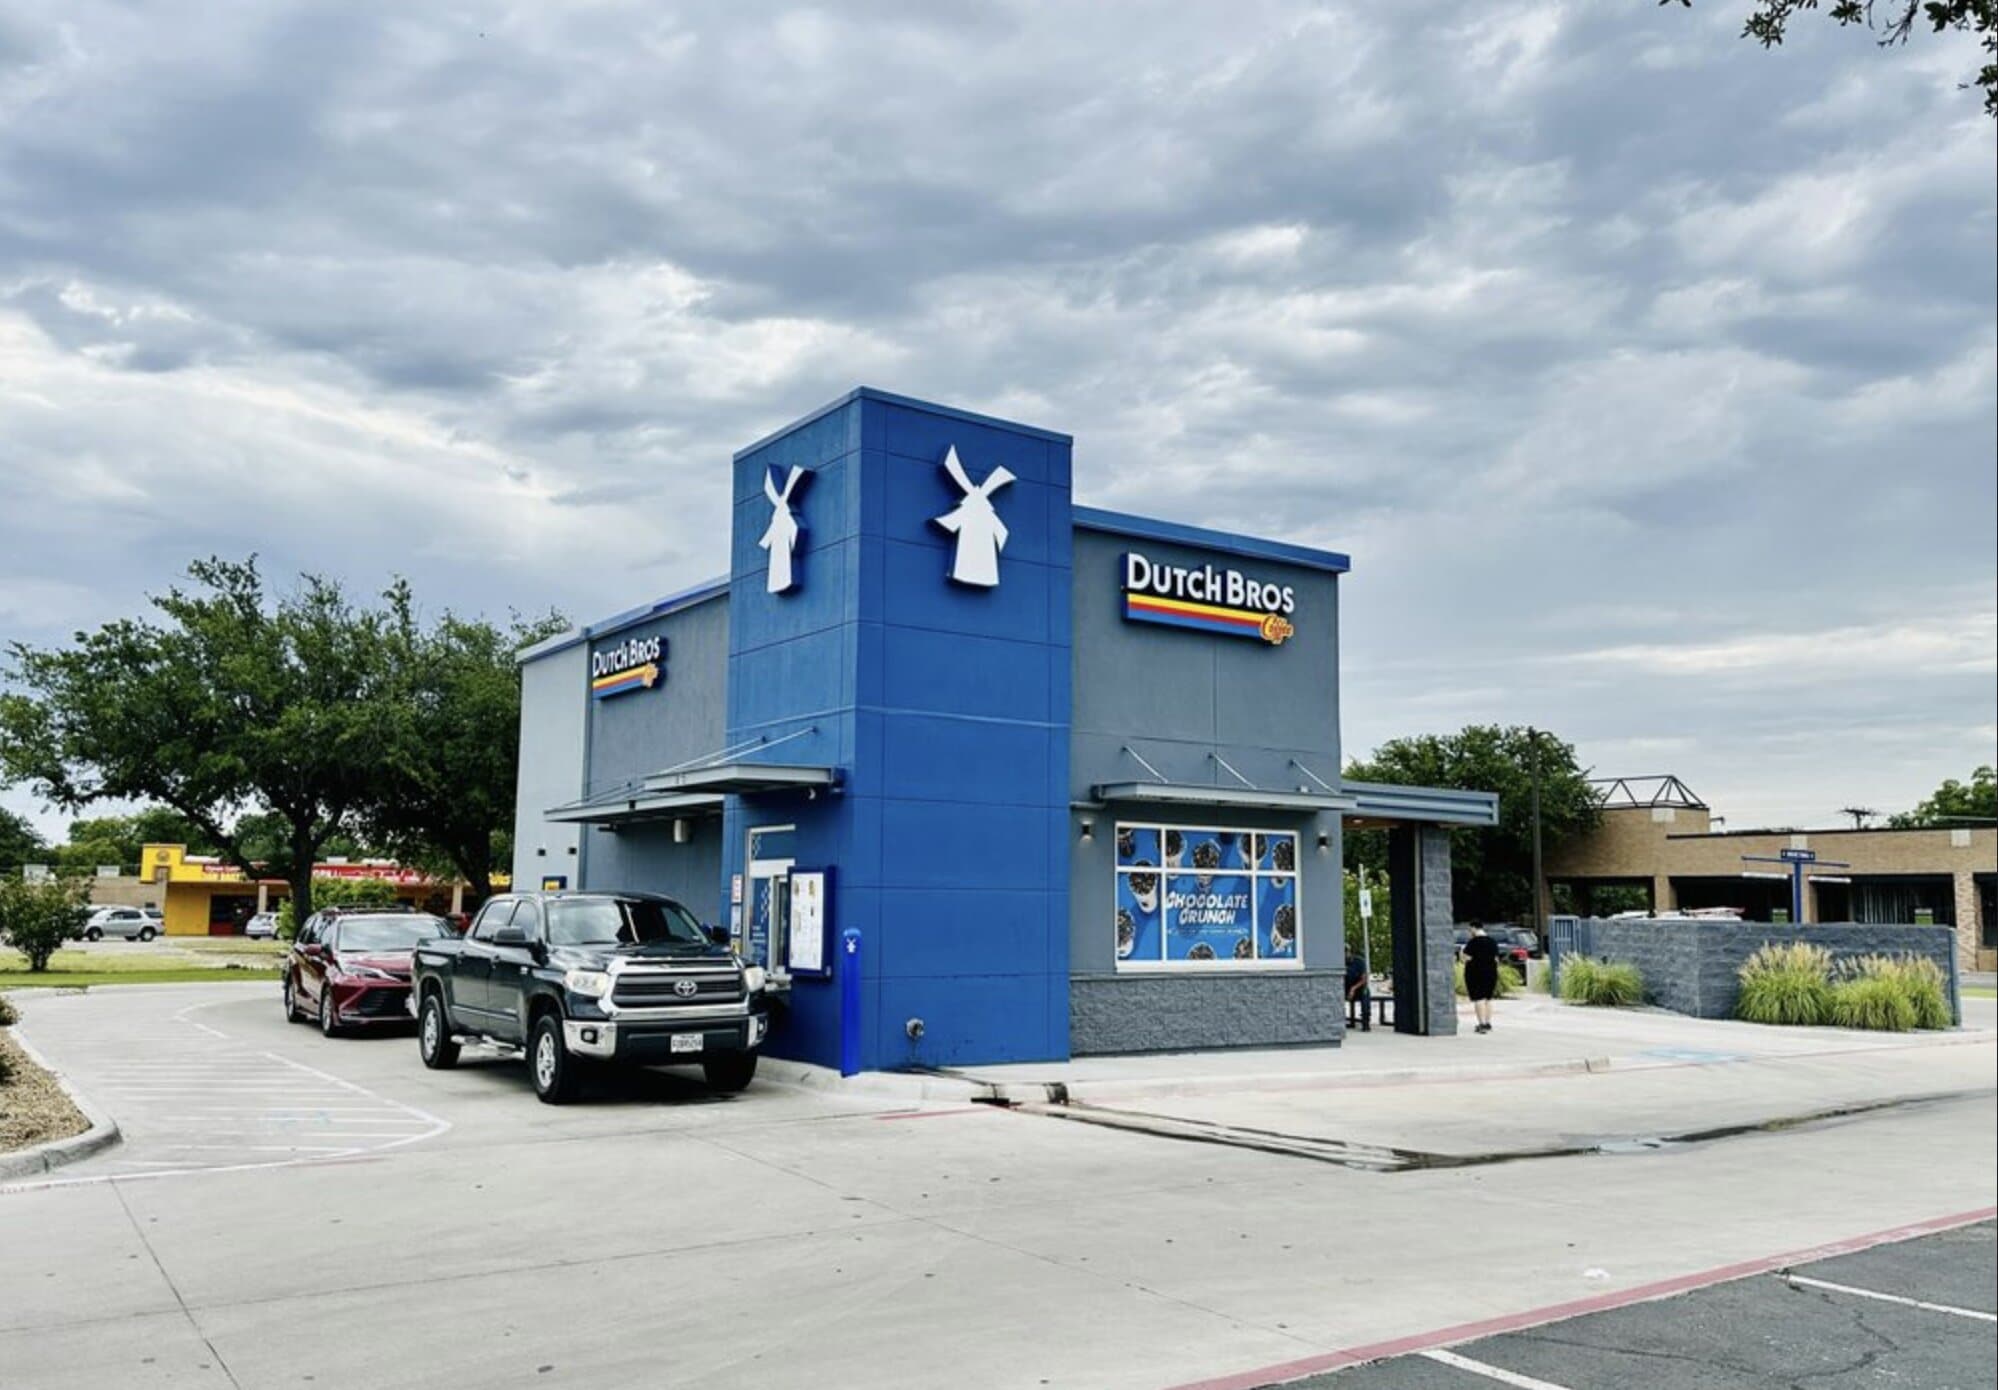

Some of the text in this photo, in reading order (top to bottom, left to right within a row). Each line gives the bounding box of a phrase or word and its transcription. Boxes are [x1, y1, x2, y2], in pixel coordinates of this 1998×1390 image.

[1226, 569, 1295, 613] BROS
[629, 636, 660, 667] BROS
[1165, 891, 1249, 910] CHOCOLATE
[1178, 908, 1236, 925] CRUNCH
